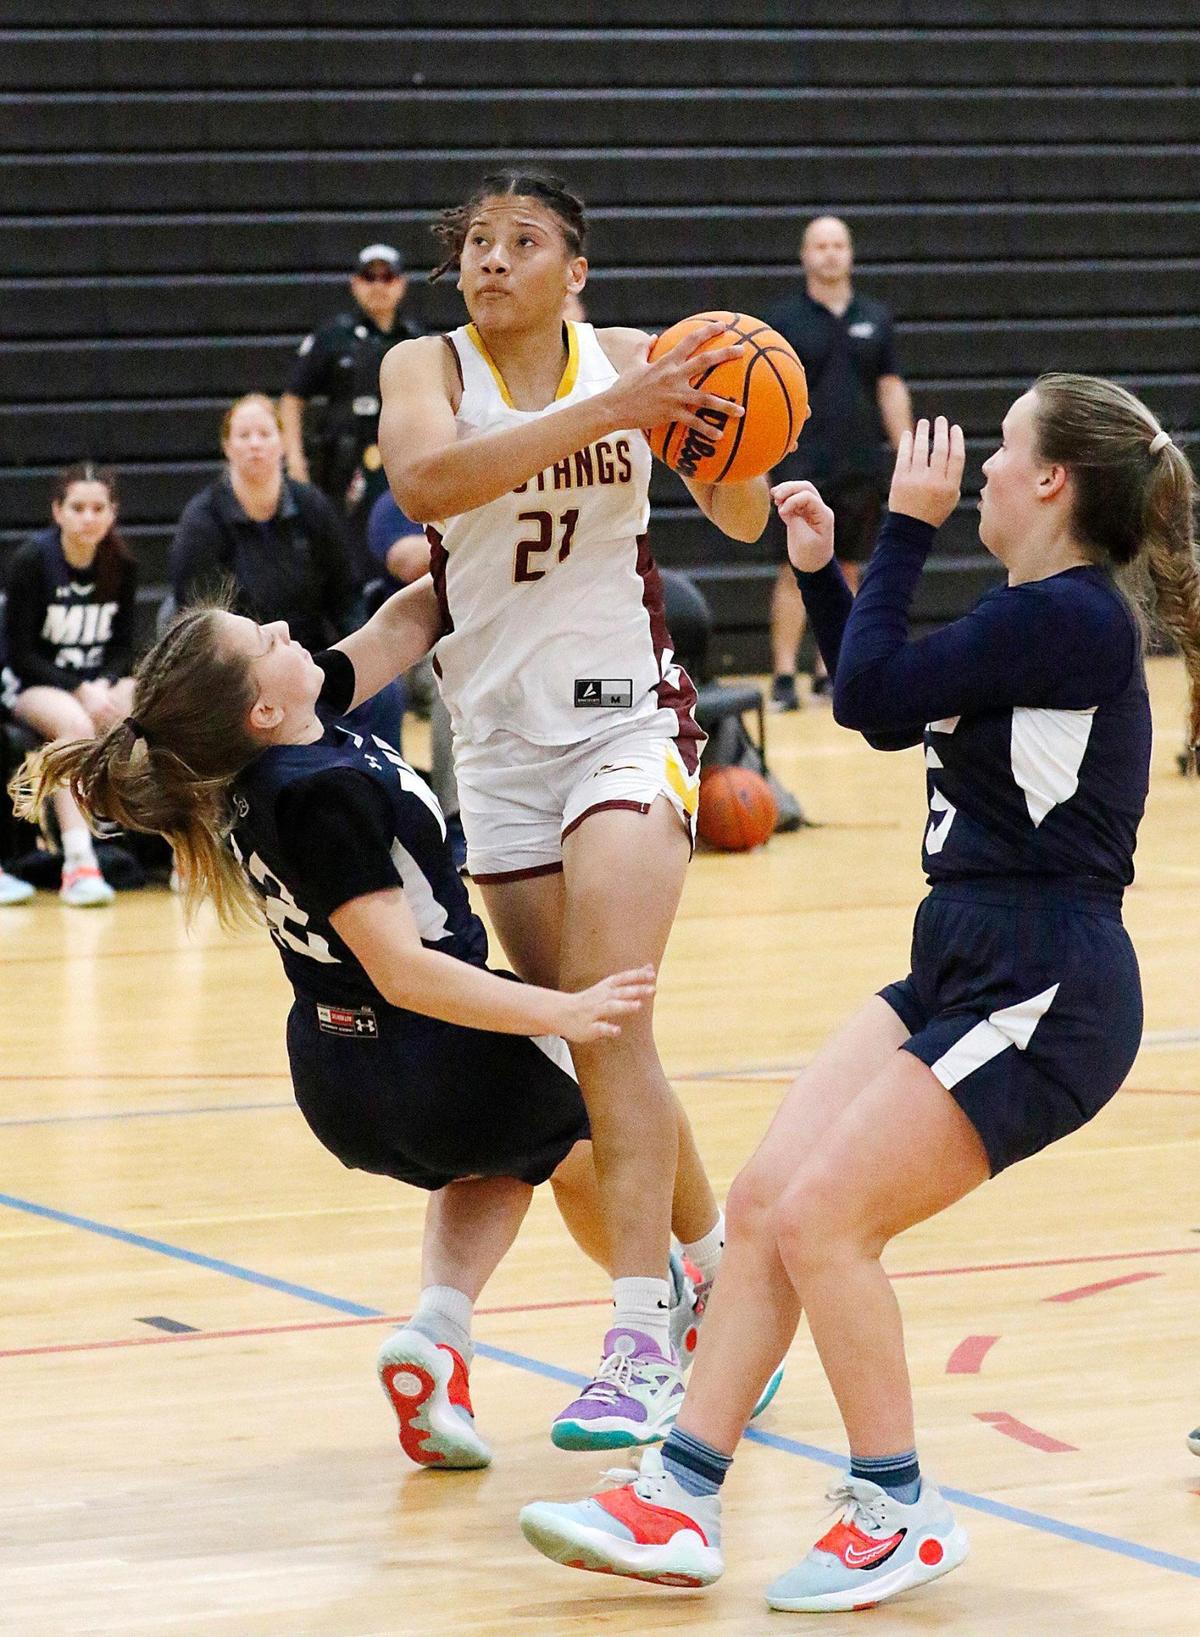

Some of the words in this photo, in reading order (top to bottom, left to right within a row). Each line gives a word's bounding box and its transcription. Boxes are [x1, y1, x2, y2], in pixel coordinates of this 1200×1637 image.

[512, 440, 632, 493] ANGS
[514, 508, 580, 583] 21
[610, 695, 621, 704] M
